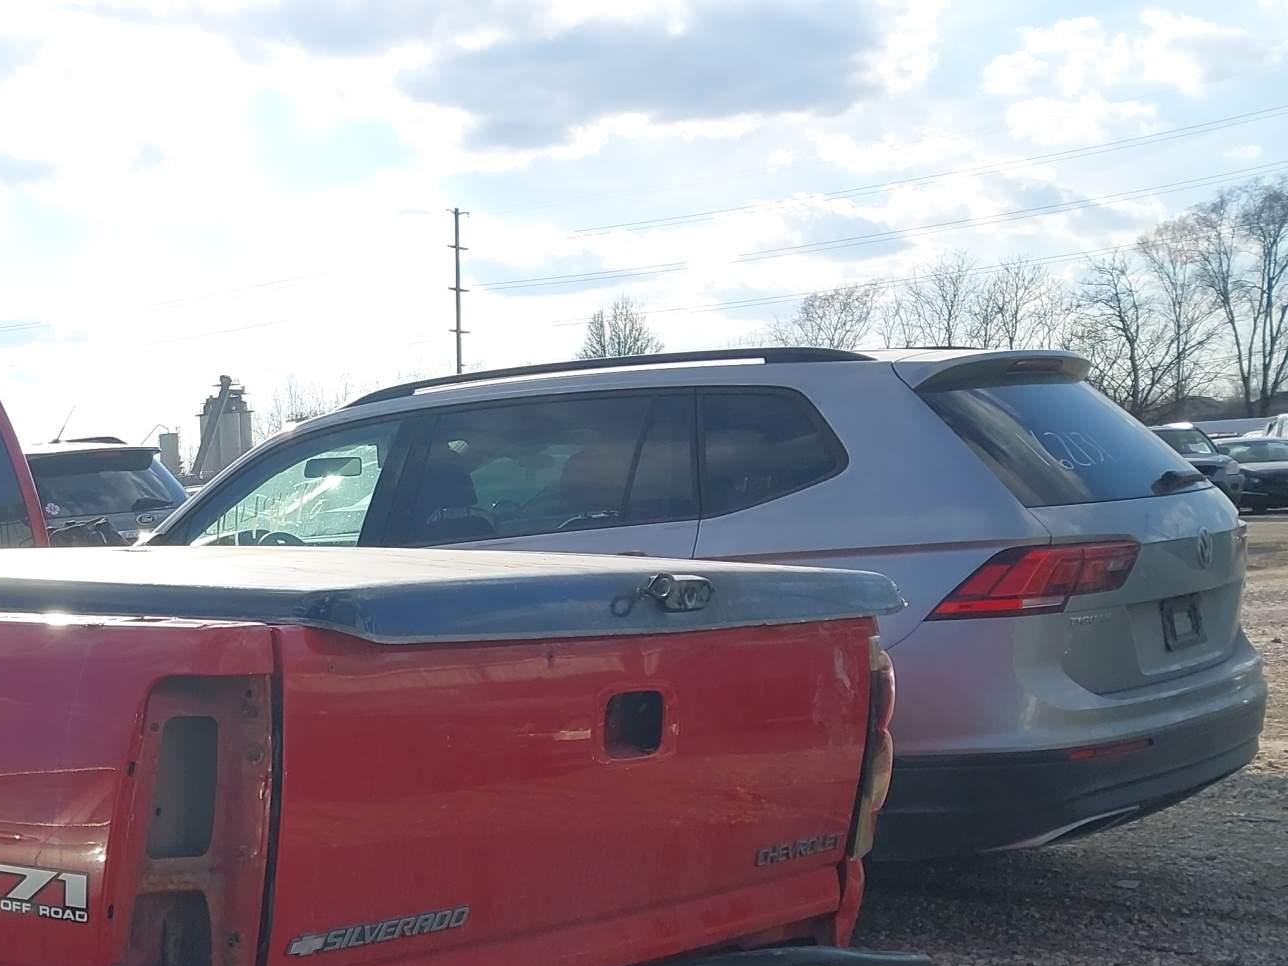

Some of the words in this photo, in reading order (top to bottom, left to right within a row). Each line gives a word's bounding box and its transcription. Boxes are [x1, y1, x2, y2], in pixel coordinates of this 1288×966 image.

[0, 899, 32, 914] OFF
[39, 904, 88, 923] ROAD
[322, 905, 470, 951] SILVERADO
